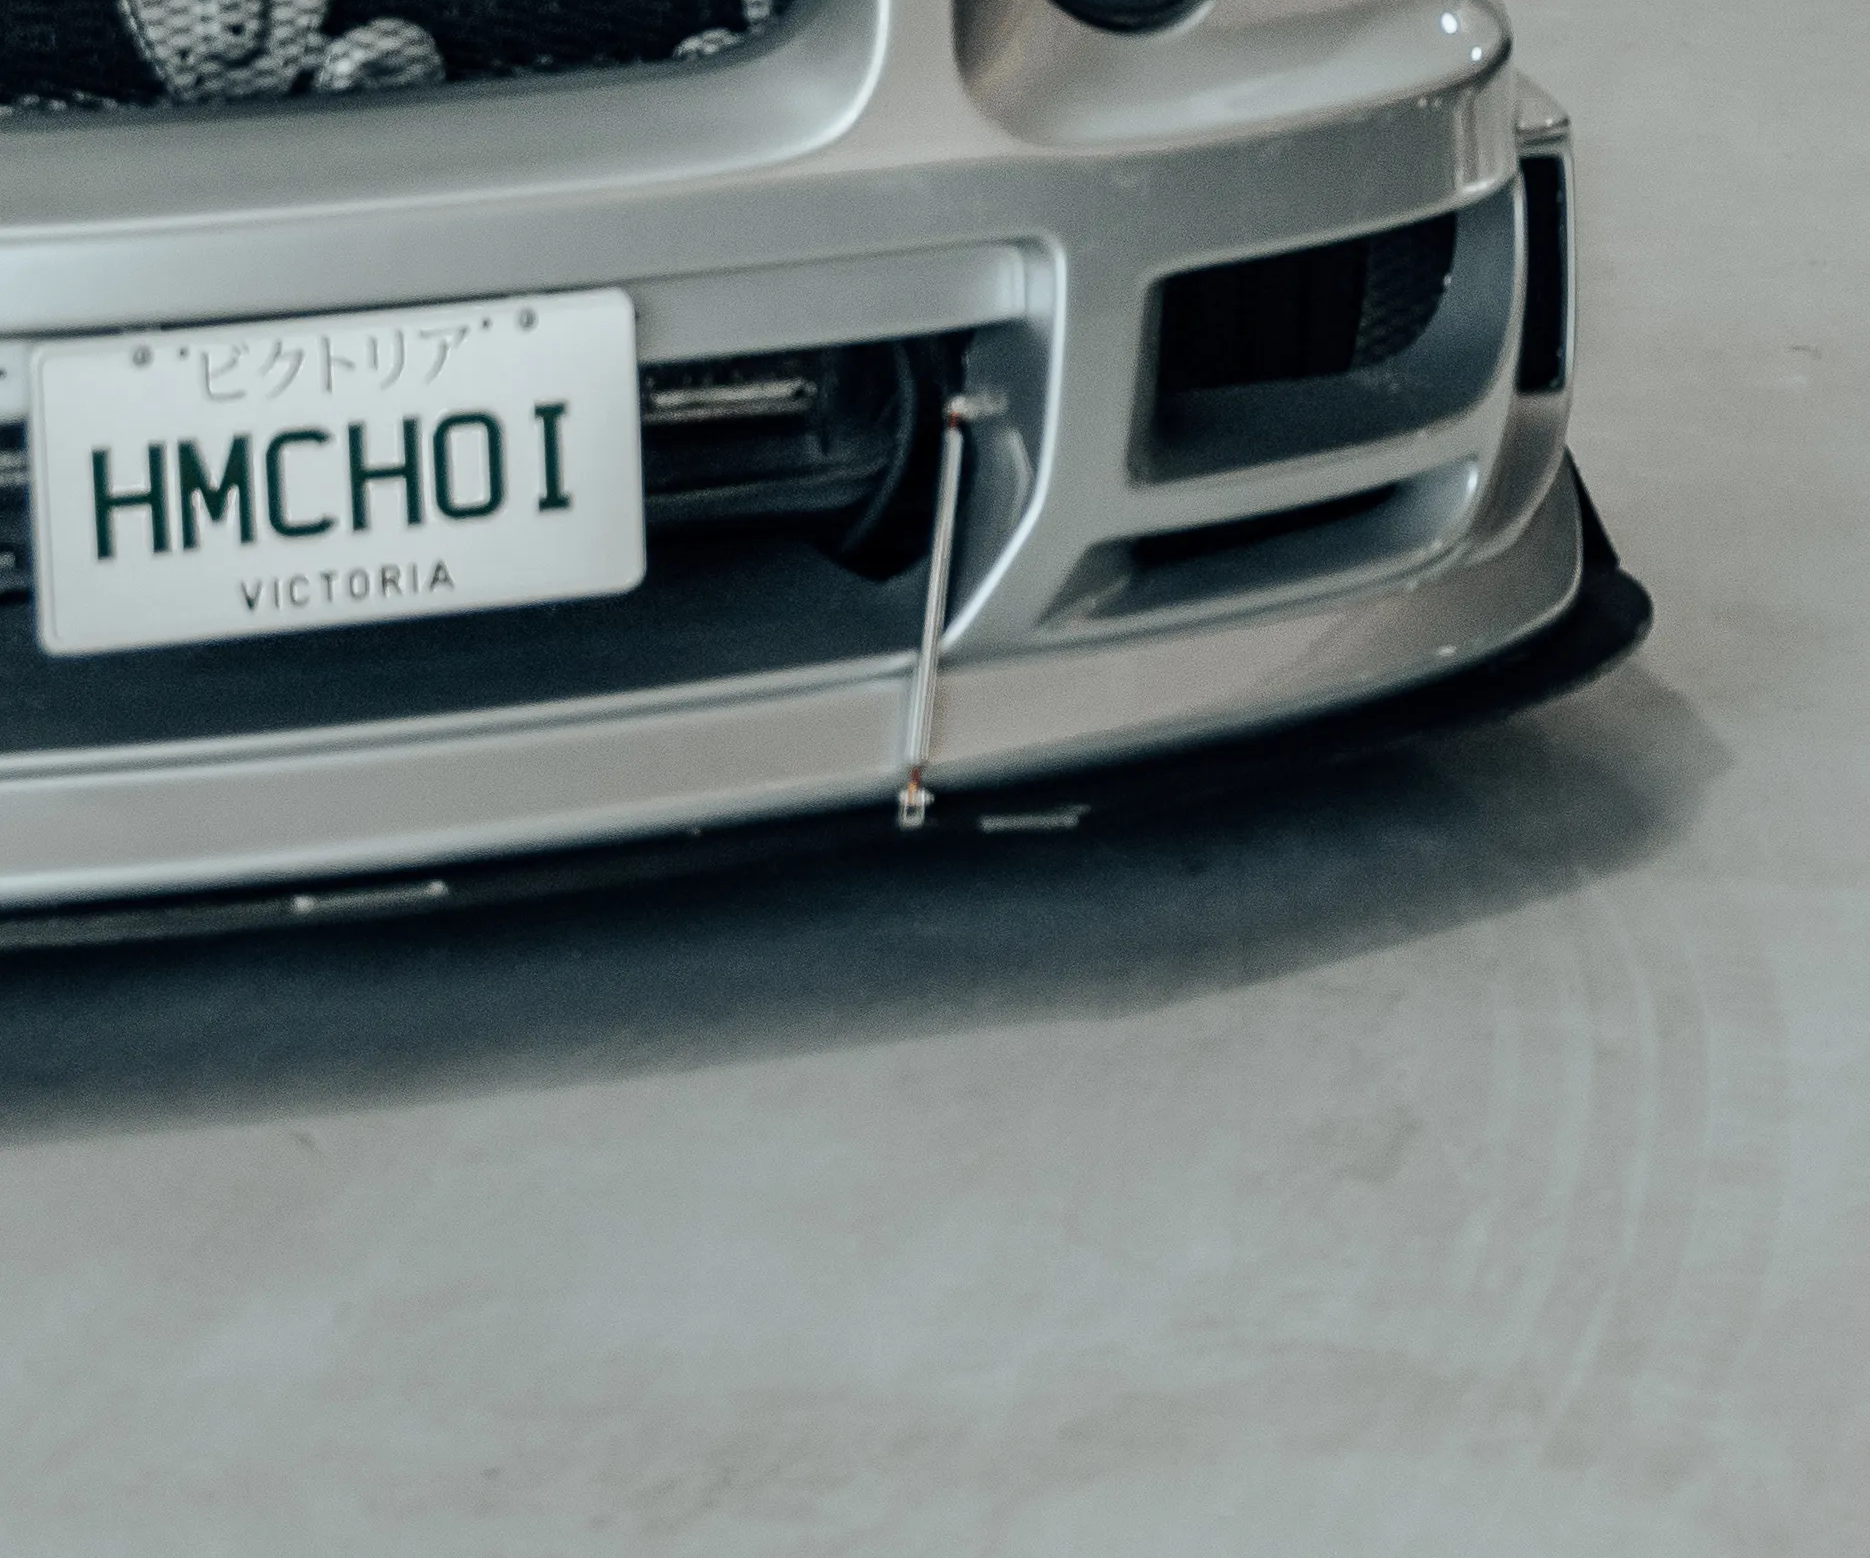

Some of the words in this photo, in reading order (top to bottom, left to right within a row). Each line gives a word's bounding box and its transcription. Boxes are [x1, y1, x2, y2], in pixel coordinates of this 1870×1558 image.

[200, 325, 472, 402] ビクトリア
[241, 559, 456, 612] VICTORIA
